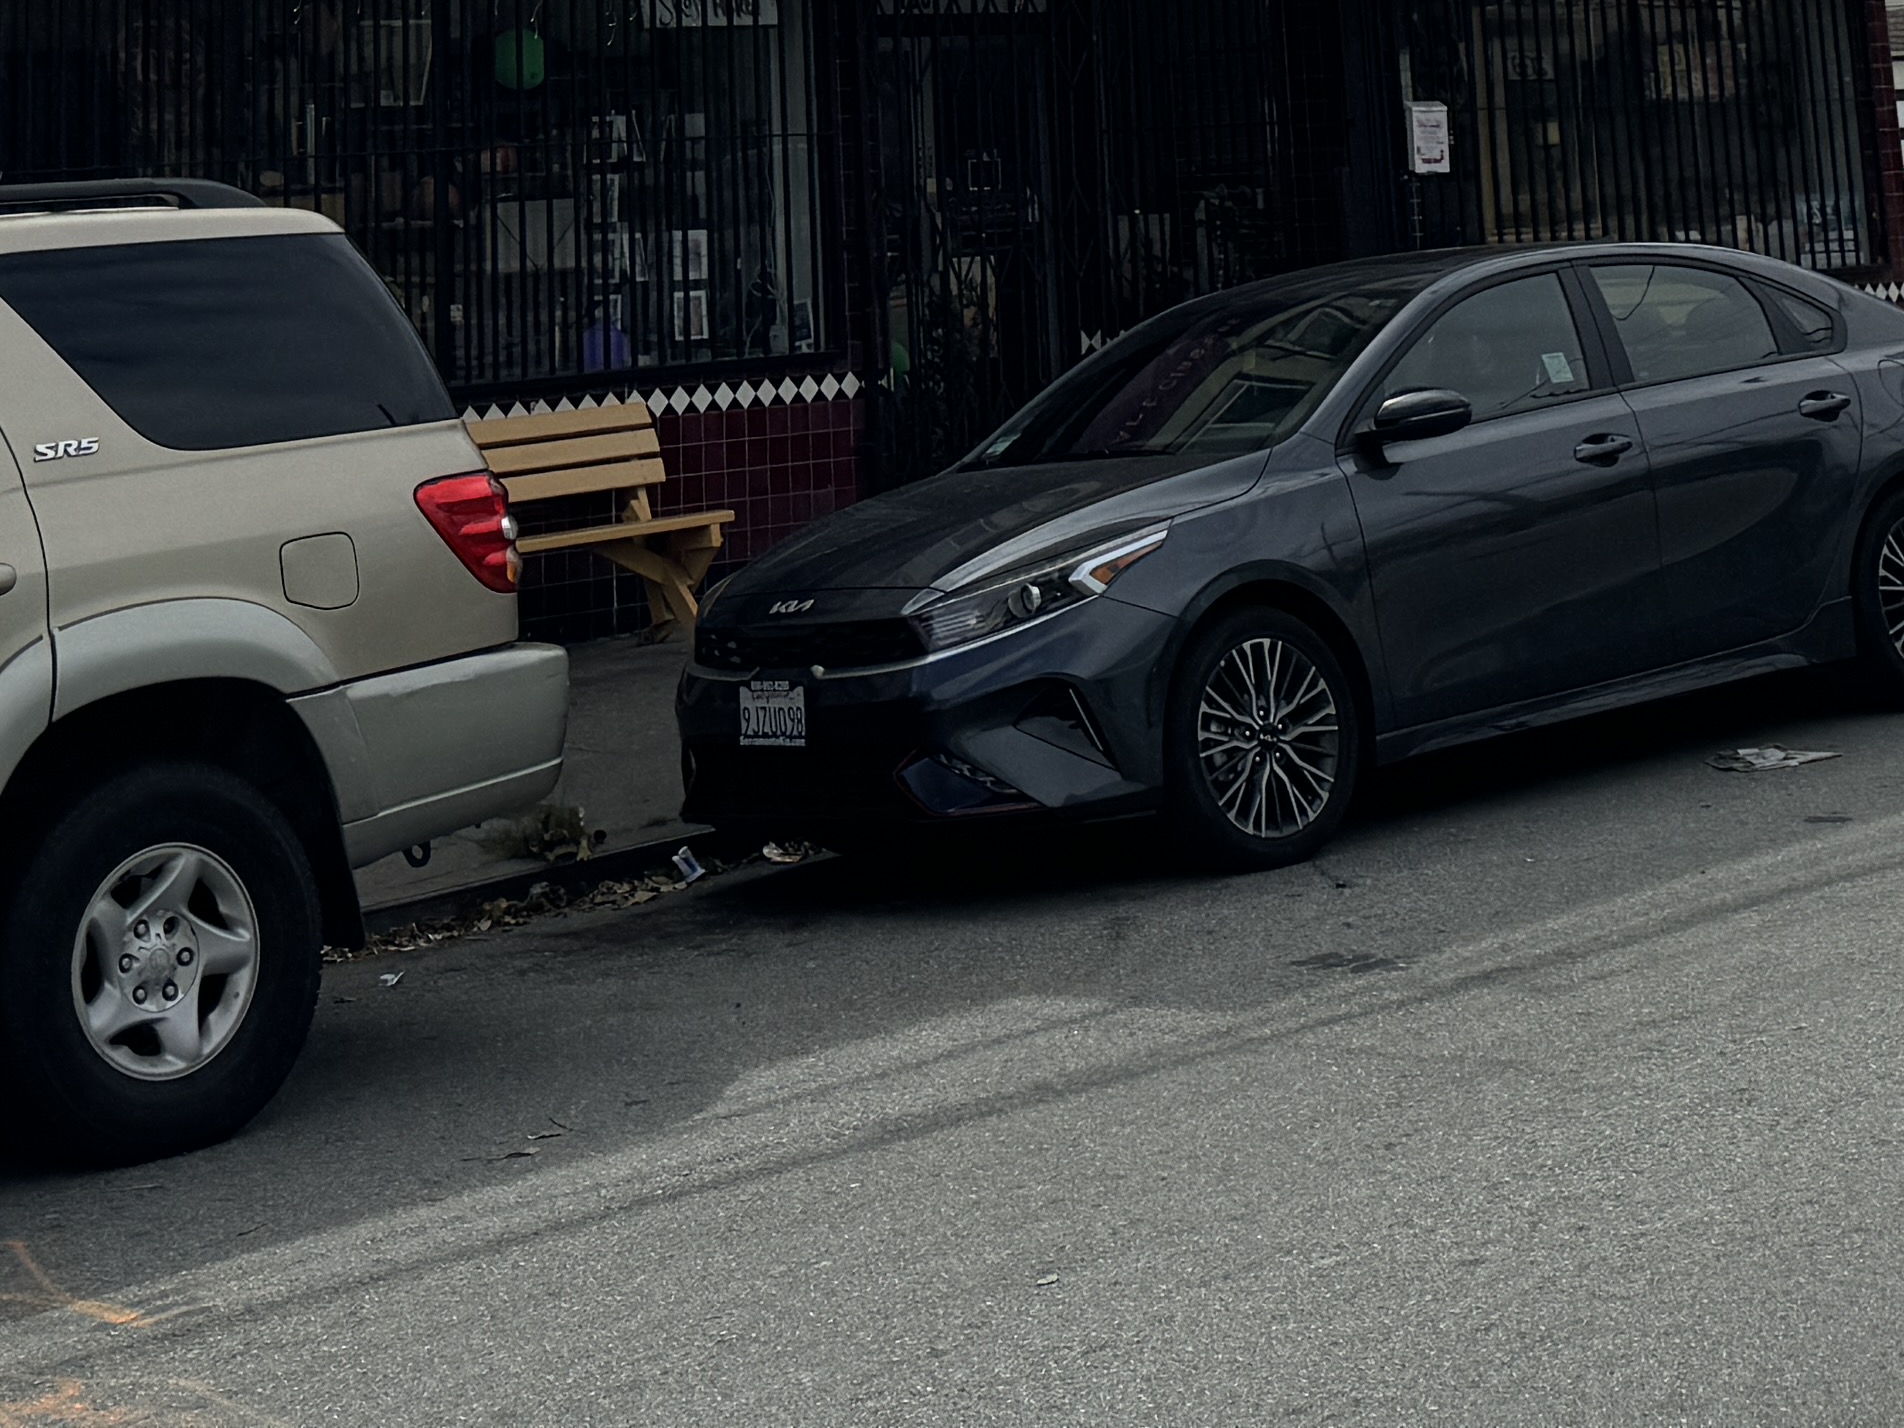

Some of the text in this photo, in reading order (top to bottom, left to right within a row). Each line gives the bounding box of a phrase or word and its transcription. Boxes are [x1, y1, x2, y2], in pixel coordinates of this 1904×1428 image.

[33, 436, 100, 462] SR5
[768, 598, 815, 614] KIA
[743, 706, 803, 736] 9JZU098
